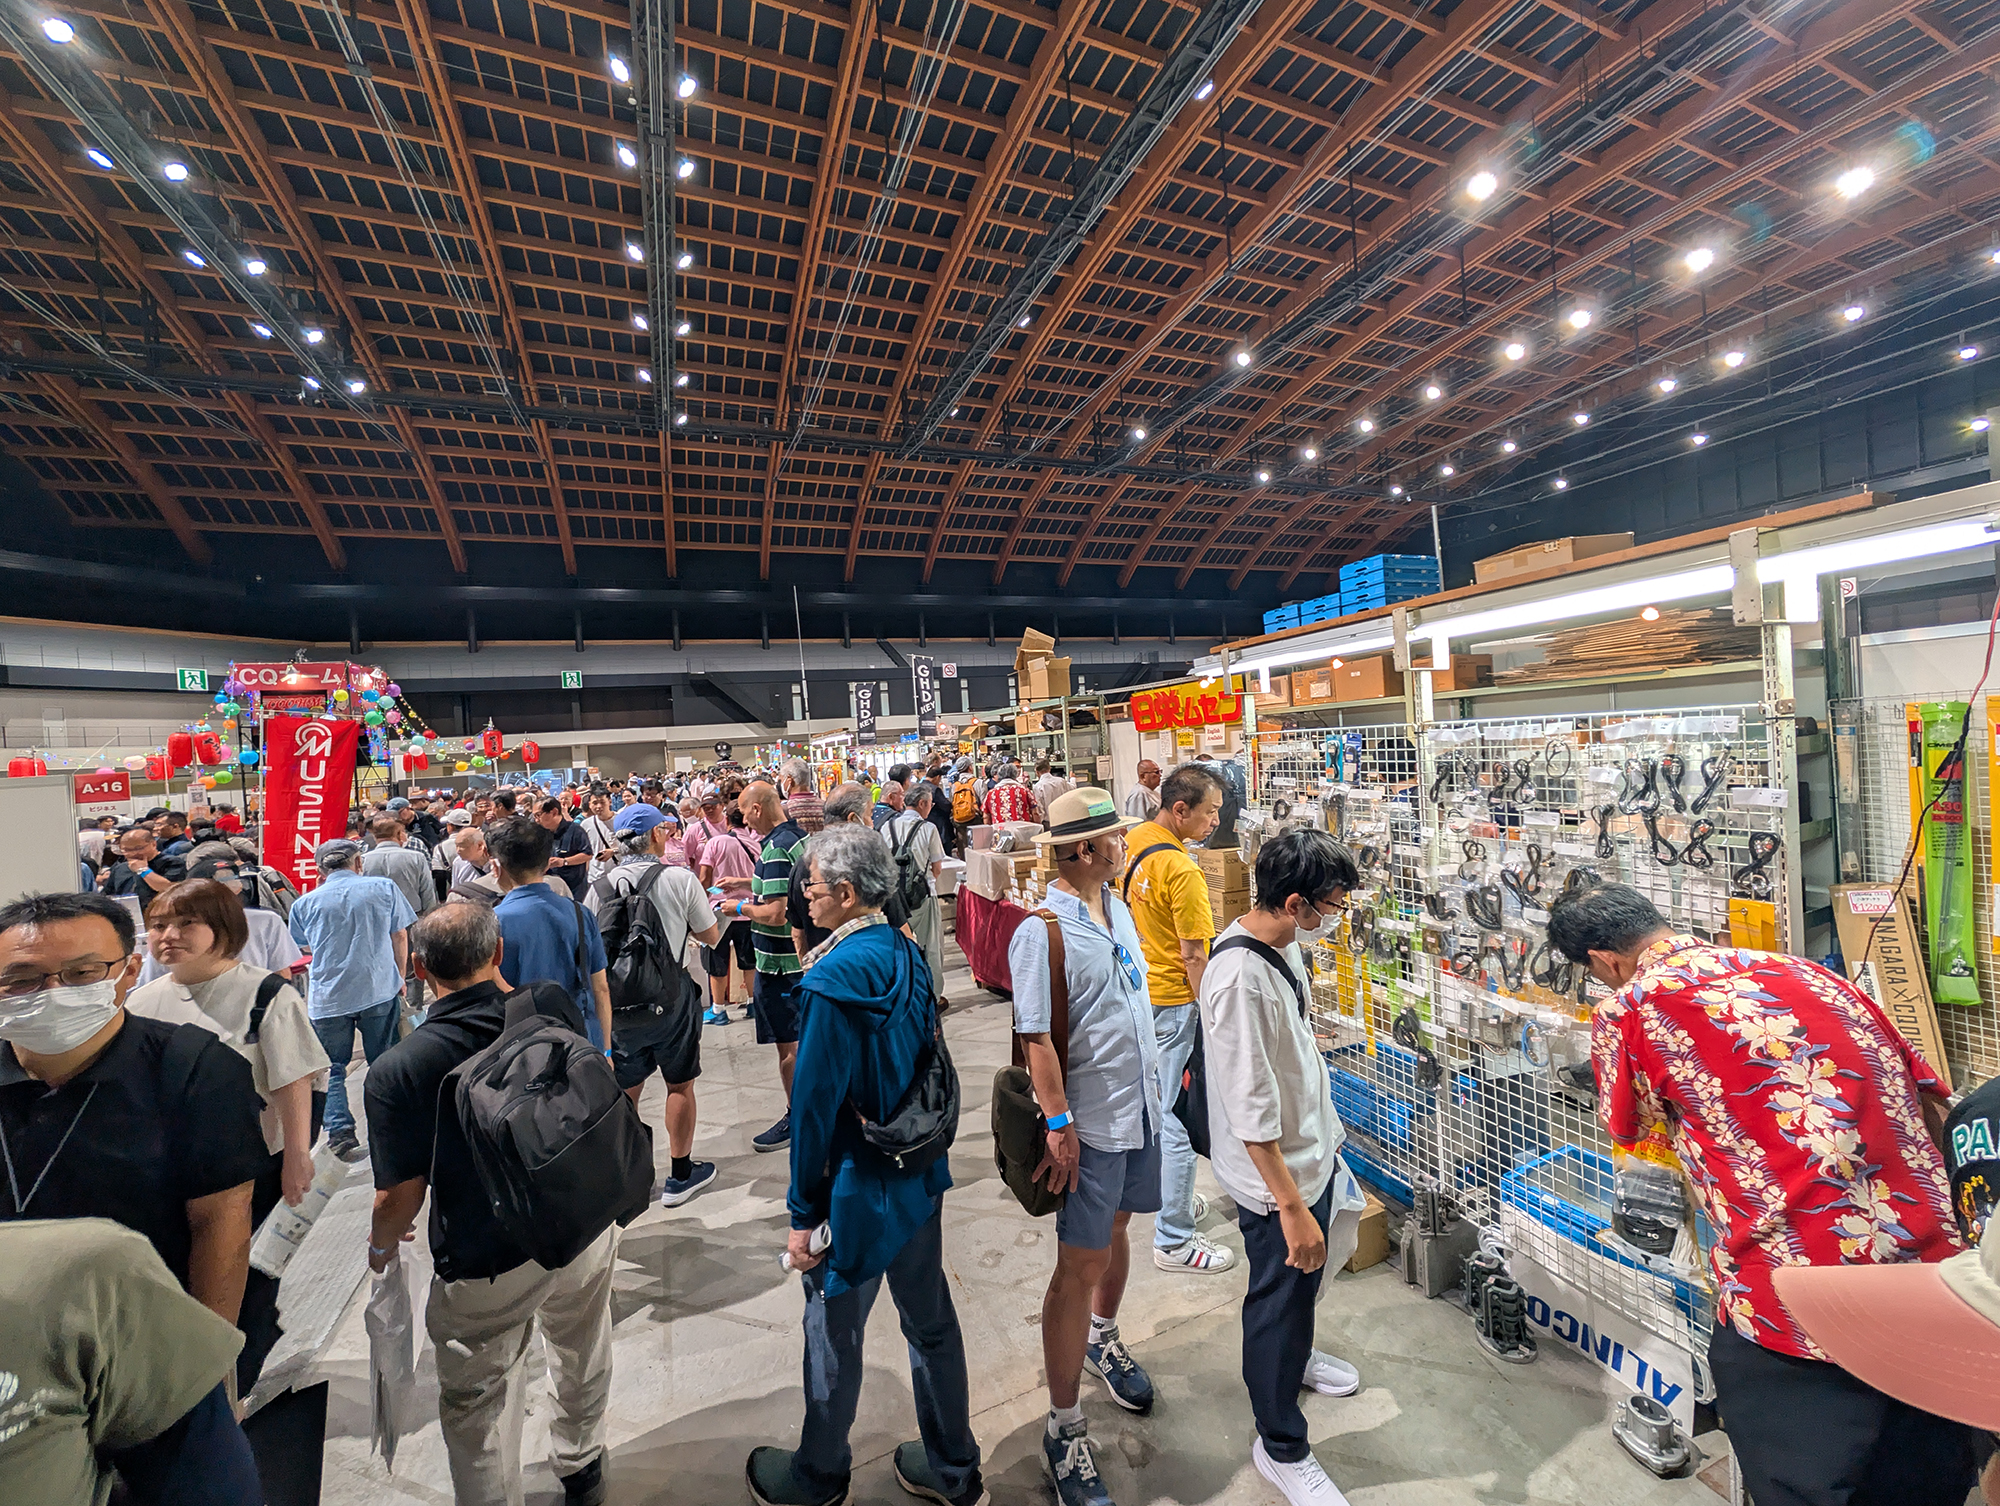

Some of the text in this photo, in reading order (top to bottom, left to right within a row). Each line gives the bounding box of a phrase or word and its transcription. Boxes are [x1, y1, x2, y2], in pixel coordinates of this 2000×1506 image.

[238, 667, 342, 686] CQオーム
[920, 700, 936, 715] KEY
[859, 716, 875, 729] KEY
[82, 781, 123, 794] A-16
[89, 805, 117, 813] ビジネス
[1952, 1118, 2000, 1167] PA
[1527, 1295, 1683, 1407] ALINCO
